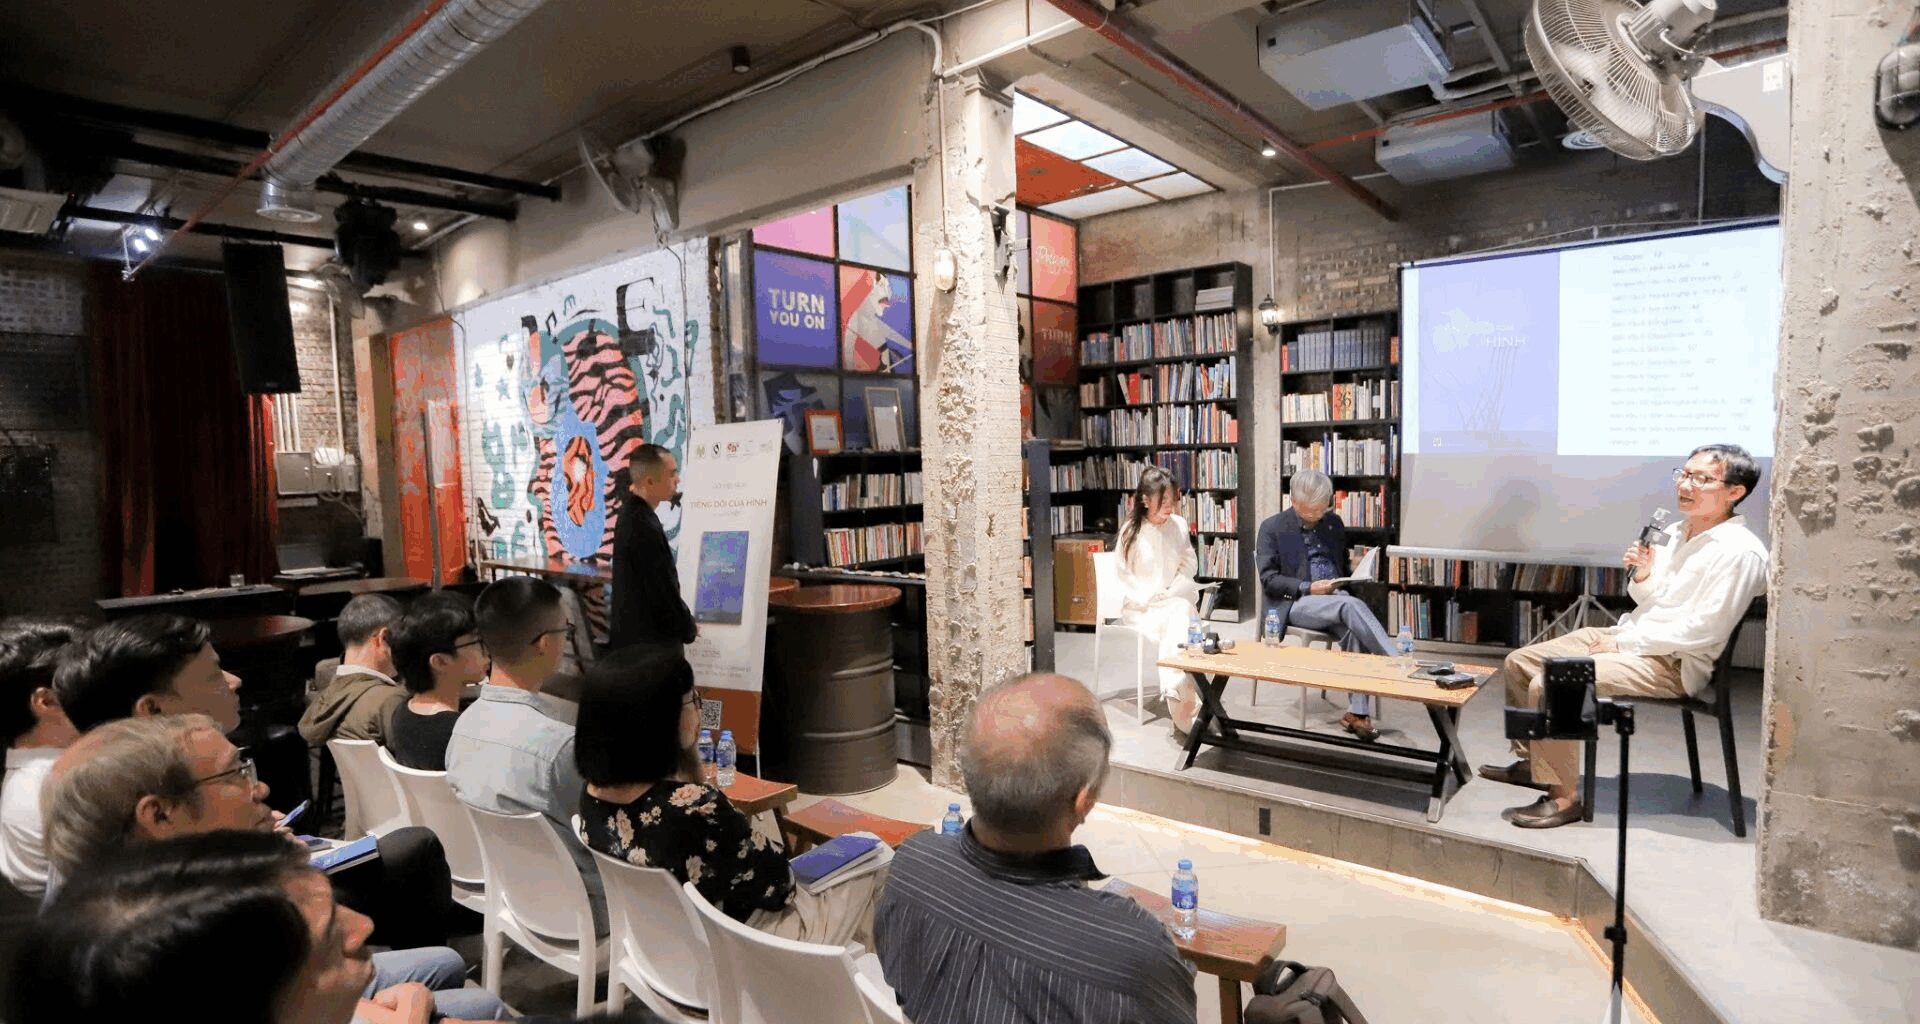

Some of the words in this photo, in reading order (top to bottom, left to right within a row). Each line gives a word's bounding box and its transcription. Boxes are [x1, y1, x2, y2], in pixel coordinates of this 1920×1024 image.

[768, 288, 826, 315] TURN
[769, 310, 800, 327] YOU
[804, 314, 826, 330] ON
